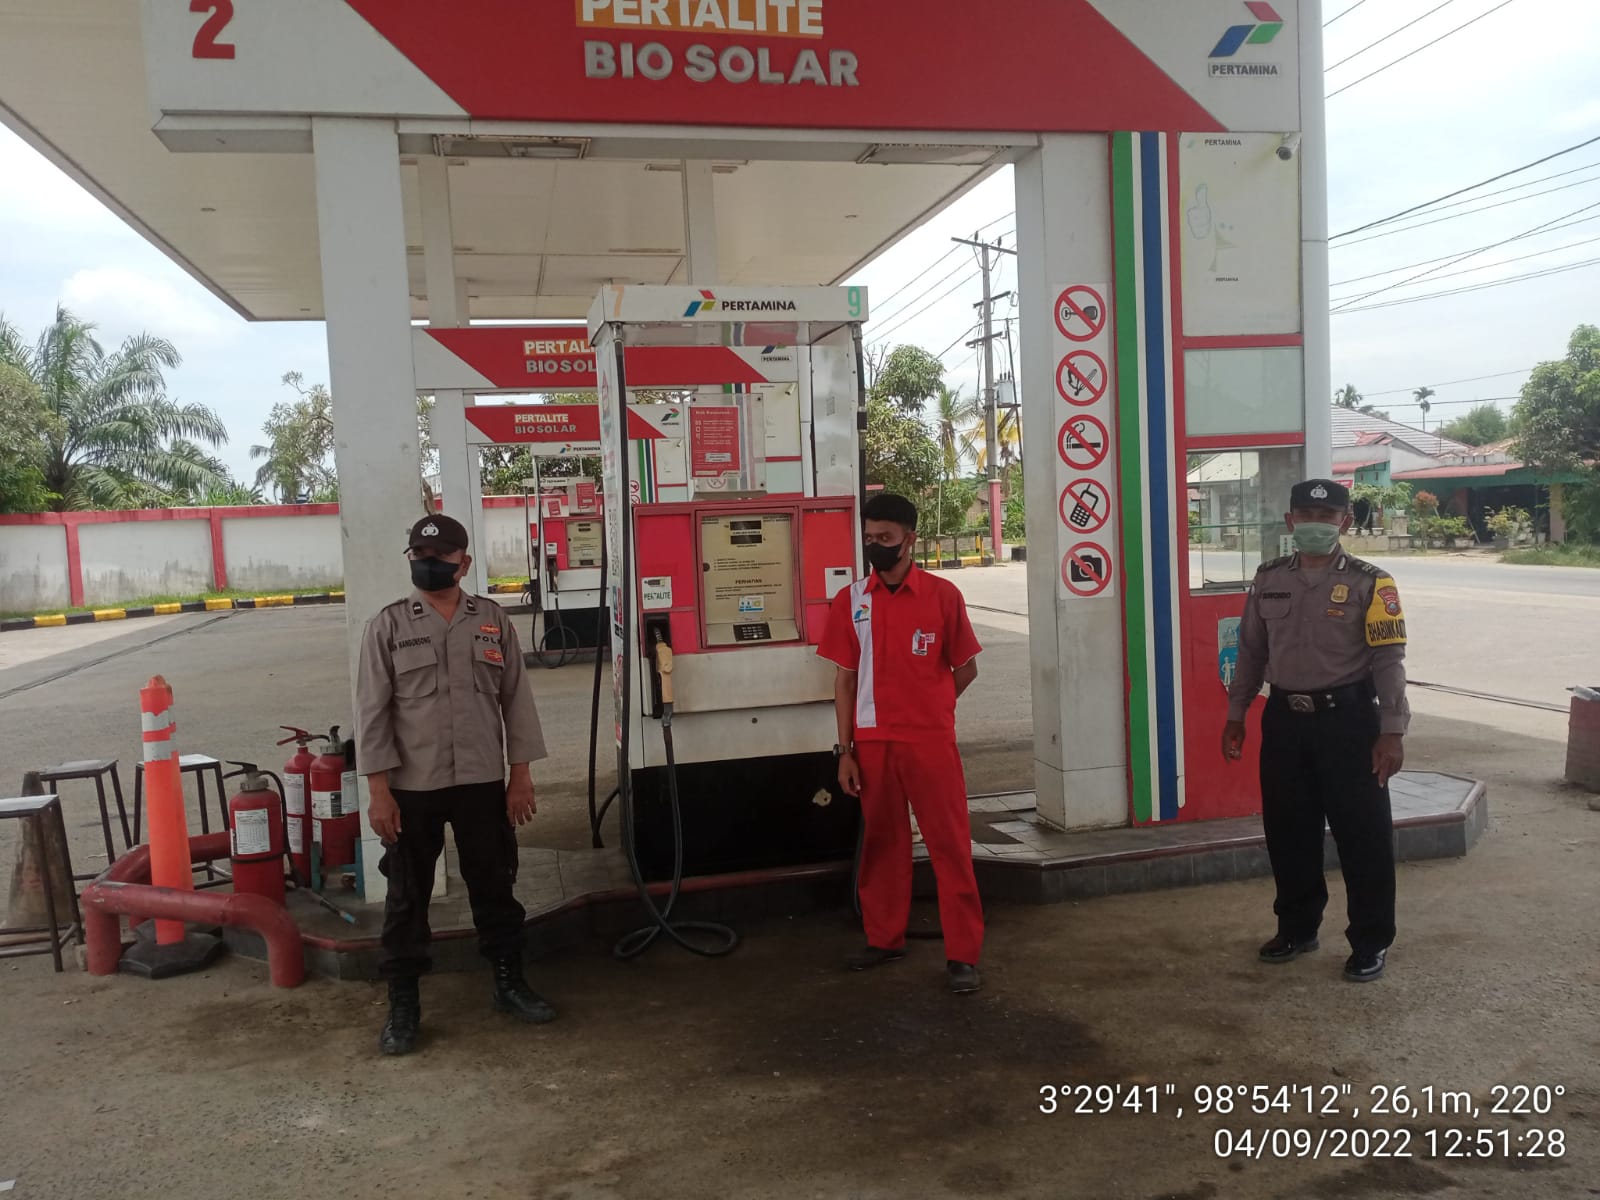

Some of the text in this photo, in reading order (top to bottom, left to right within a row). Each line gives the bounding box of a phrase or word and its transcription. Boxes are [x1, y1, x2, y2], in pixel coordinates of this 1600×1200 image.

[581, 0, 824, 35] PERTALITE
[189, 0, 236, 59] 2
[583, 40, 860, 87] BIO SOLAR
[1211, 64, 1278, 76] PERTAMINA
[1204, 138, 1242, 146] PERTAMINA
[610, 286, 625, 318] 7
[721, 300, 797, 312] PERTAMINA
[847, 286, 861, 318] 9
[526, 359, 558, 374] BIO
[514, 413, 569, 423] PERTALITE
[514, 424, 577, 434] BIO SOLAR
